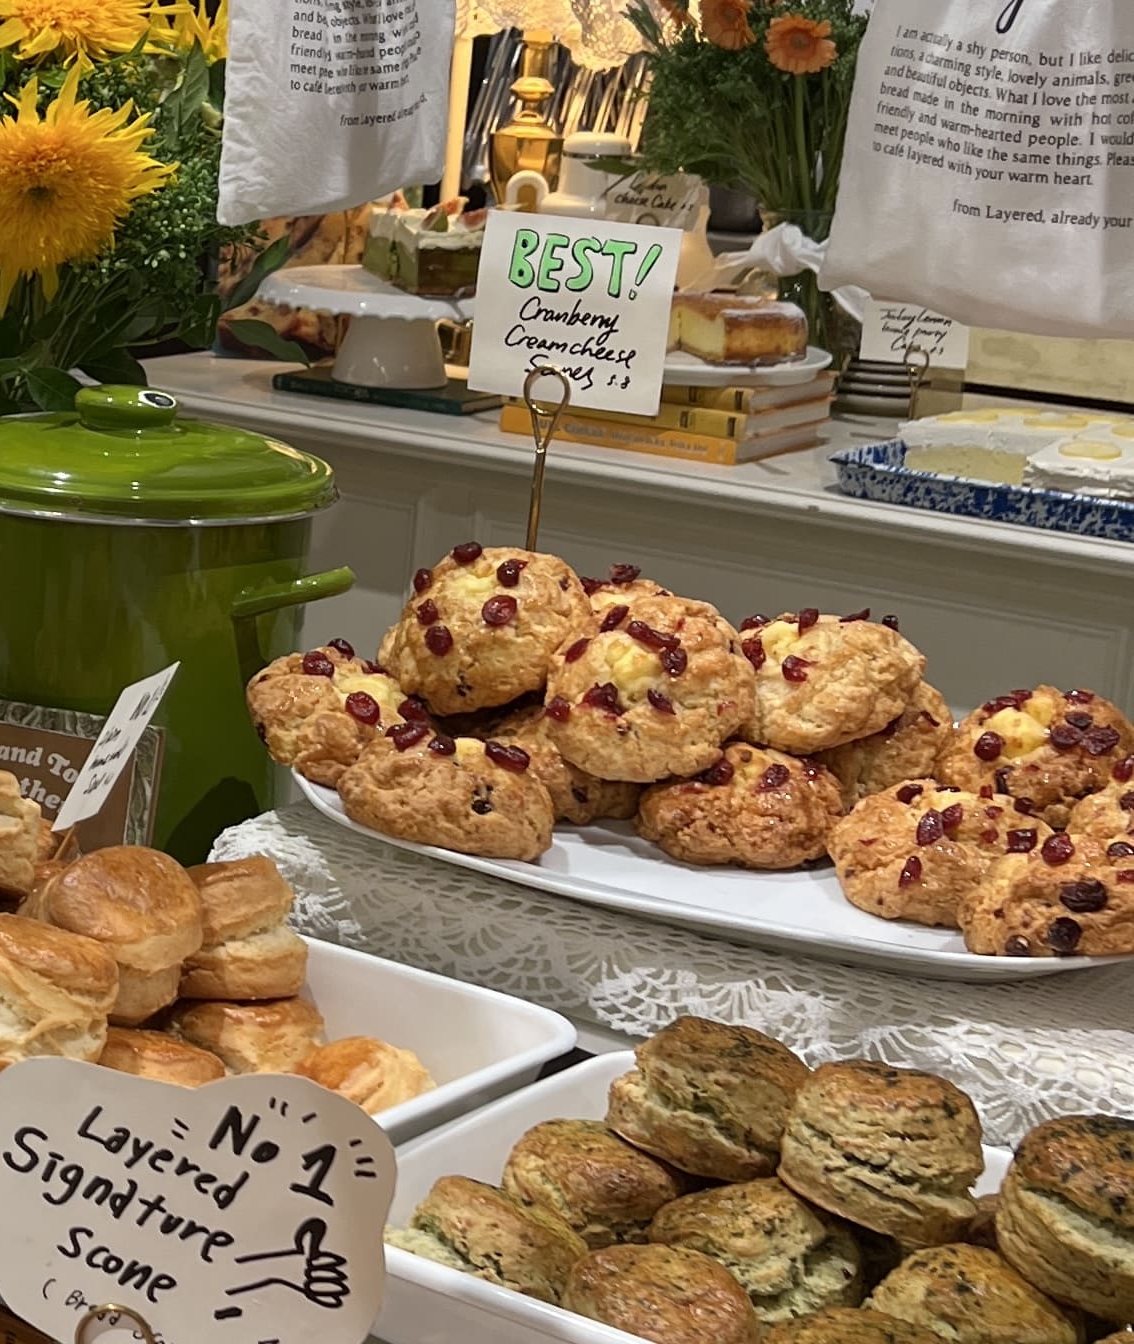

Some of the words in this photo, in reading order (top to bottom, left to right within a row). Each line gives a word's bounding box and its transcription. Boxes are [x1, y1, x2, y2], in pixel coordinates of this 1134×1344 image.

[903, 28, 917, 40] am
[920, 30, 953, 51] actually
[956, 40, 963, 51] a
[967, 41, 986, 59] shy
[990, 47, 1033, 66] person,
[1039, 53, 1063, 67] but
[1069, 54, 1074, 66] I
[1079, 52, 1101, 66] like
[918, 52, 924, 62] a
[924, 52, 972, 77] charming
[975, 64, 1004, 82] style,
[1007, 69, 1047, 89] lovely
[880, 82, 910, 99] bread
[913, 90, 939, 107] made
[944, 96, 954, 110] in
[961, 100, 979, 116] the
[985, 108, 1041, 128] morning
[1050, 114, 1083, 127] with
[1092, 113, 1112, 126] hot
[884, 65, 905, 78] and
[905, 68, 947, 89] beautiful
[948, 78, 991, 99] objects.
[996, 88, 1028, 105] What
[1033, 92, 1037, 105] I
[1042, 92, 1071, 106] love
[1076, 92, 1097, 106] the
[1101, 93, 1129, 105] most
[874, 122, 899, 137] meet
[901, 127, 934, 146] people
[937, 137, 960, 152] who
[964, 141, 983, 158] like
[987, 148, 1008, 162] the
[1012, 151, 1051, 165] same
[1056, 152, 1102, 169] things.
[876, 101, 916, 123] friendly
[918, 113, 938, 126] and
[941, 118, 1022, 144] warm-hearted
[1028, 133, 1083, 149] people.
[1090, 134, 1095, 146] I
[1101, 132, 1133, 146] would
[872, 140, 882, 152] to
[884, 141, 904, 157] café
[906, 146, 945, 169] layered
[948, 159, 973, 176] with
[974, 167, 1005, 181] your
[1008, 172, 1049, 184] warm
[1054, 172, 1094, 186] heart.
[953, 199, 980, 219] from
[986, 205, 1046, 223] Layered,
[1051, 210, 1100, 229] already
[1103, 215, 1133, 230] your
[509, 229, 662, 301] BEST!
[519, 296, 620, 345] Cranberry
[77, 1104, 250, 1209] Layered
[2, 1126, 235, 1263] Signature
